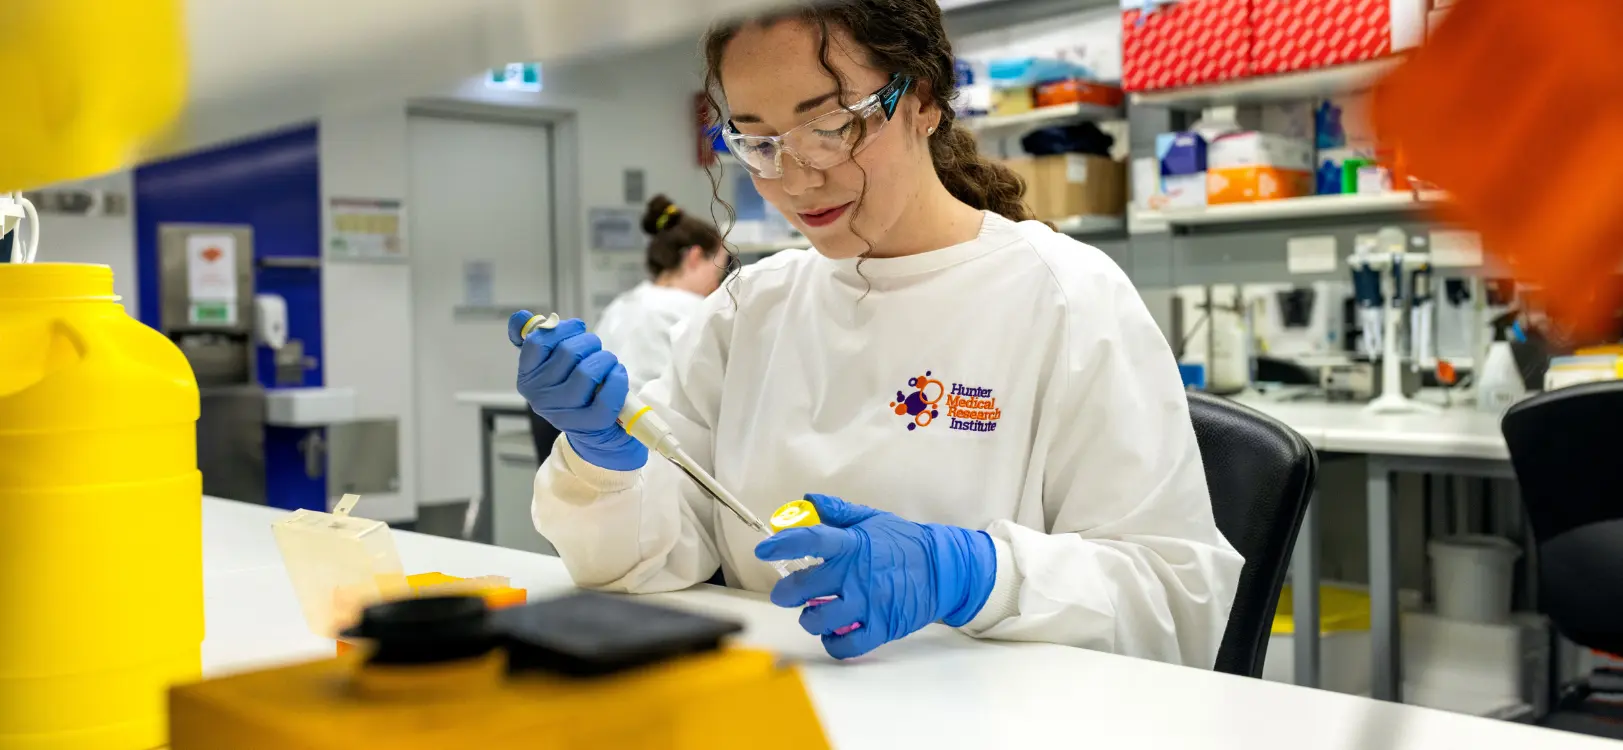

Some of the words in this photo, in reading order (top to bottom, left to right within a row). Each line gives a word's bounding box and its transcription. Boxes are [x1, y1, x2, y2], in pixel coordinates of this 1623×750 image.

[950, 383, 993, 398] Hunter
[945, 394, 995, 409] Medical
[947, 406, 1001, 420] Research
[949, 417, 997, 432] Institute
